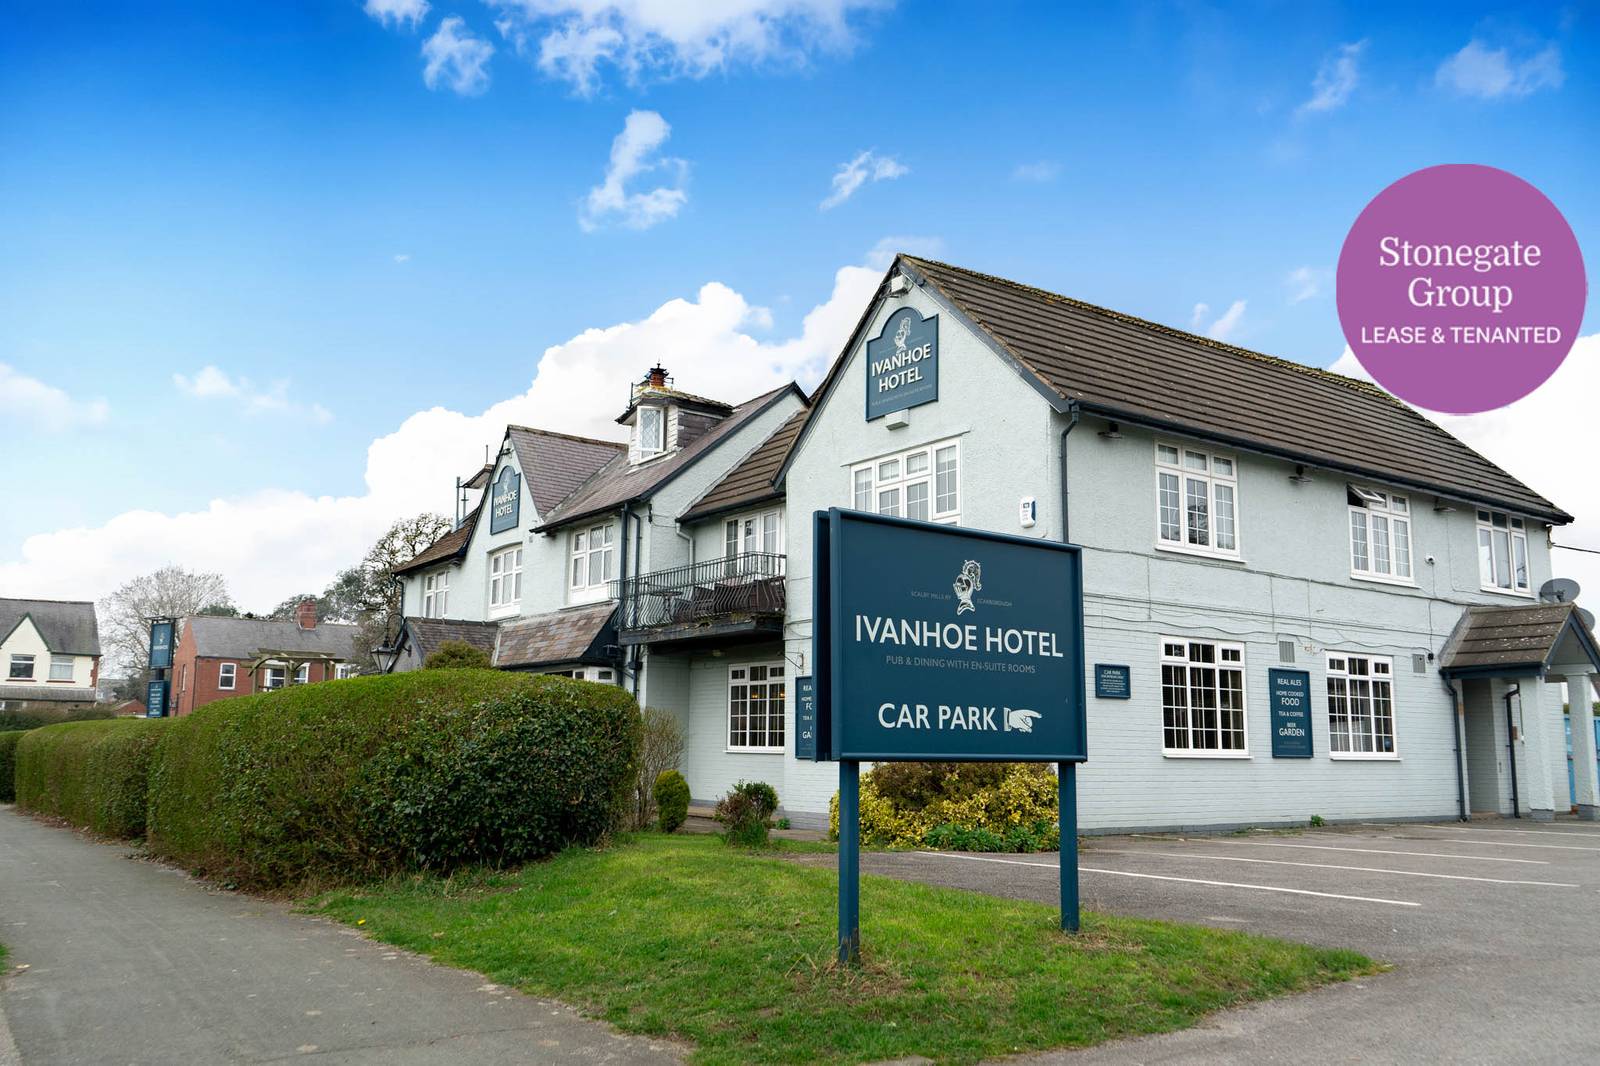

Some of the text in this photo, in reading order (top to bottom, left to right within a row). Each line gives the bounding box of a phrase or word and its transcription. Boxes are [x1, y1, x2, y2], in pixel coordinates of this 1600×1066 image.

[872, 343, 931, 376] IVANHOE
[879, 366, 922, 393] HOTEL
[495, 503, 513, 518] HOTEL
[855, 614, 1064, 657] IVANHOE HOTEL
[886, 655, 904, 665] PUB
[905, 656, 912, 665] &
[914, 657, 946, 668] DINING
[946, 659, 970, 669] WITH
[1008, 663, 1036, 674] ROOMS
[1277, 678, 1290, 686] REAL
[1281, 697, 1299, 706] FOOD
[878, 702, 998, 731] CAR PARK
[1279, 728, 1305, 737] GARDEN
